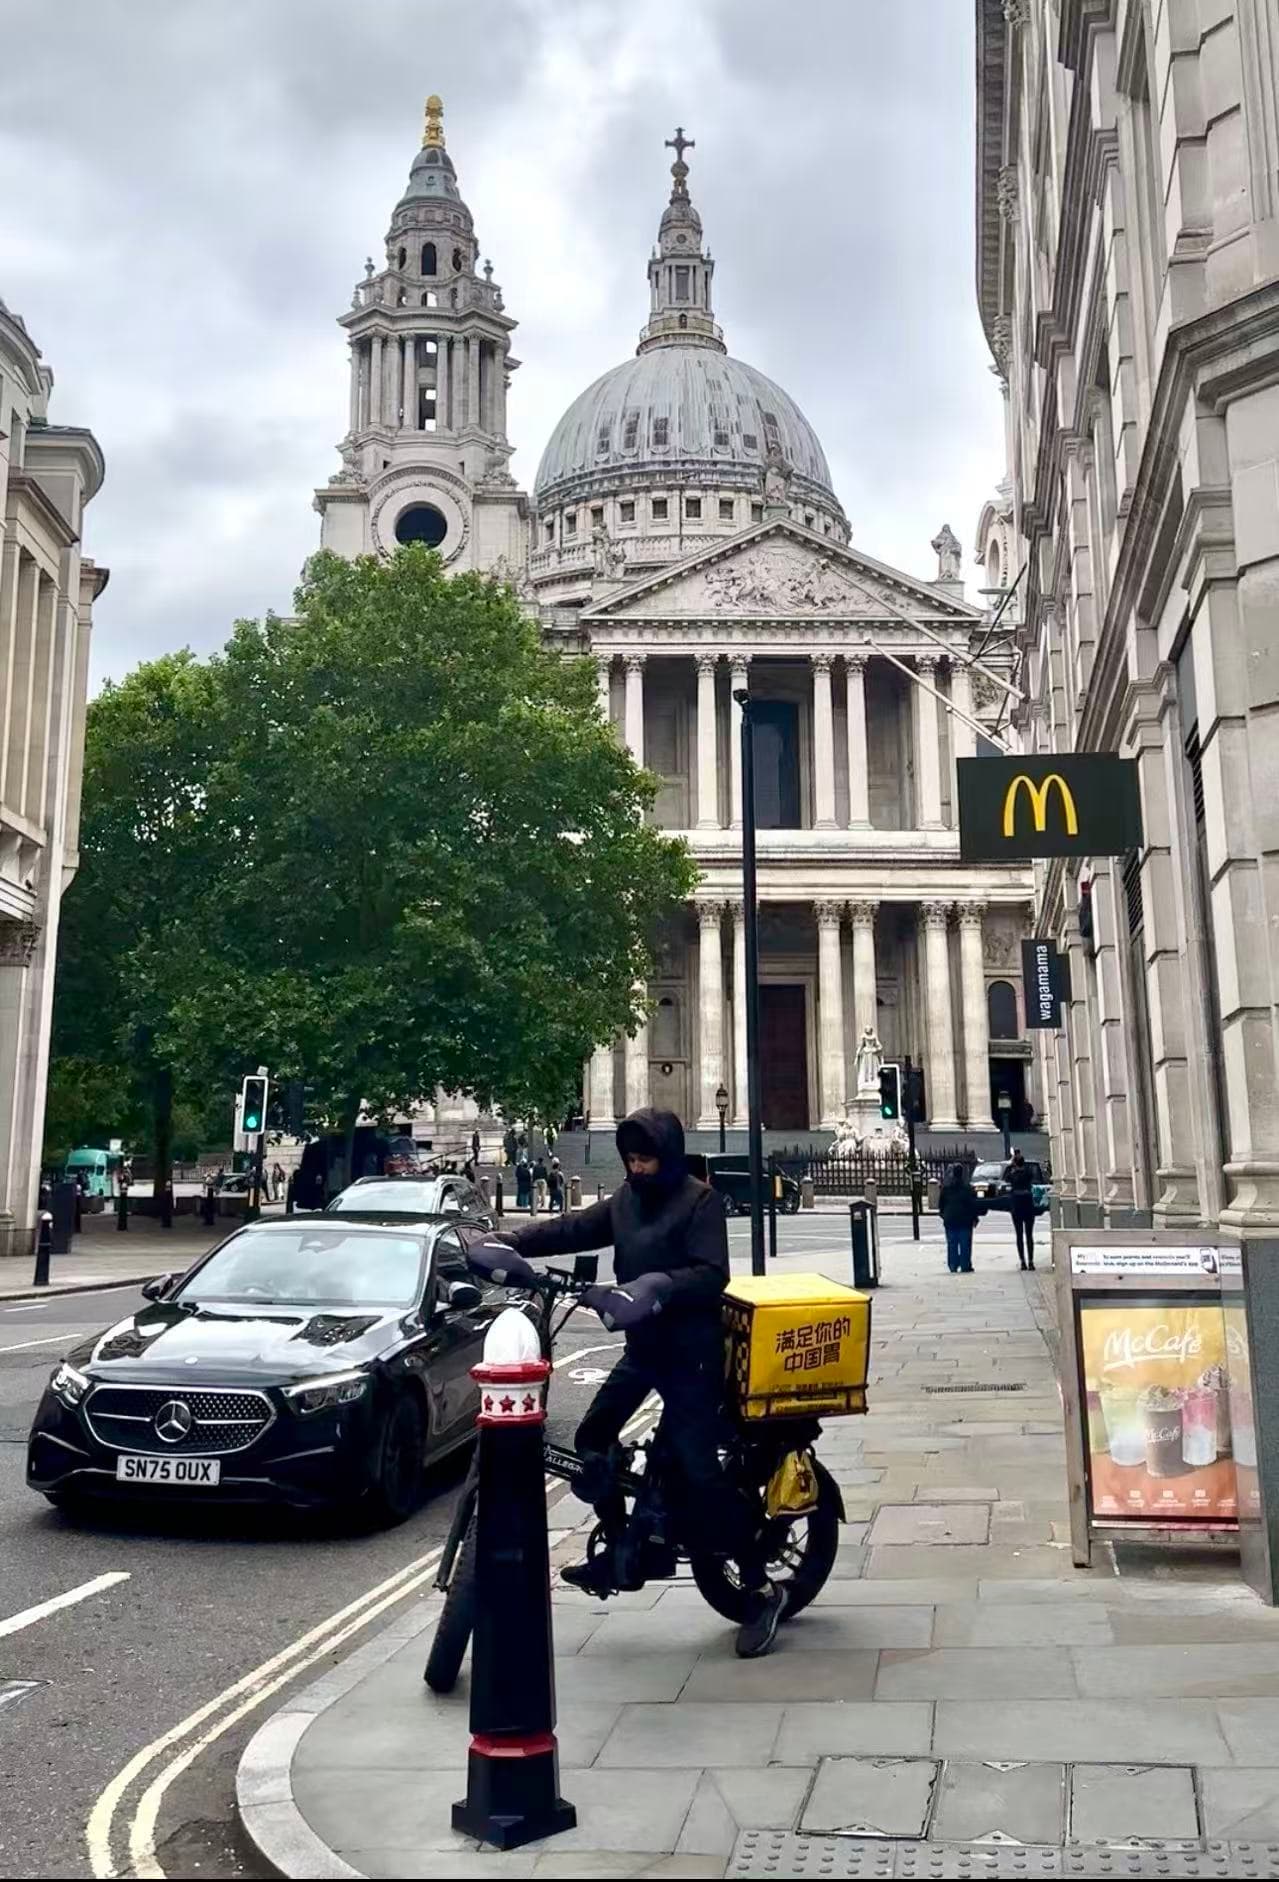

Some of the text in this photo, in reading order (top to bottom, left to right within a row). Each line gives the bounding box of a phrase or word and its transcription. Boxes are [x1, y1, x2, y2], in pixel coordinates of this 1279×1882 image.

[1036, 945, 1054, 1021] wagamama
[776, 1316, 851, 1353] 满足你的
[125, 1459, 212, 1481] SN75 OUX
